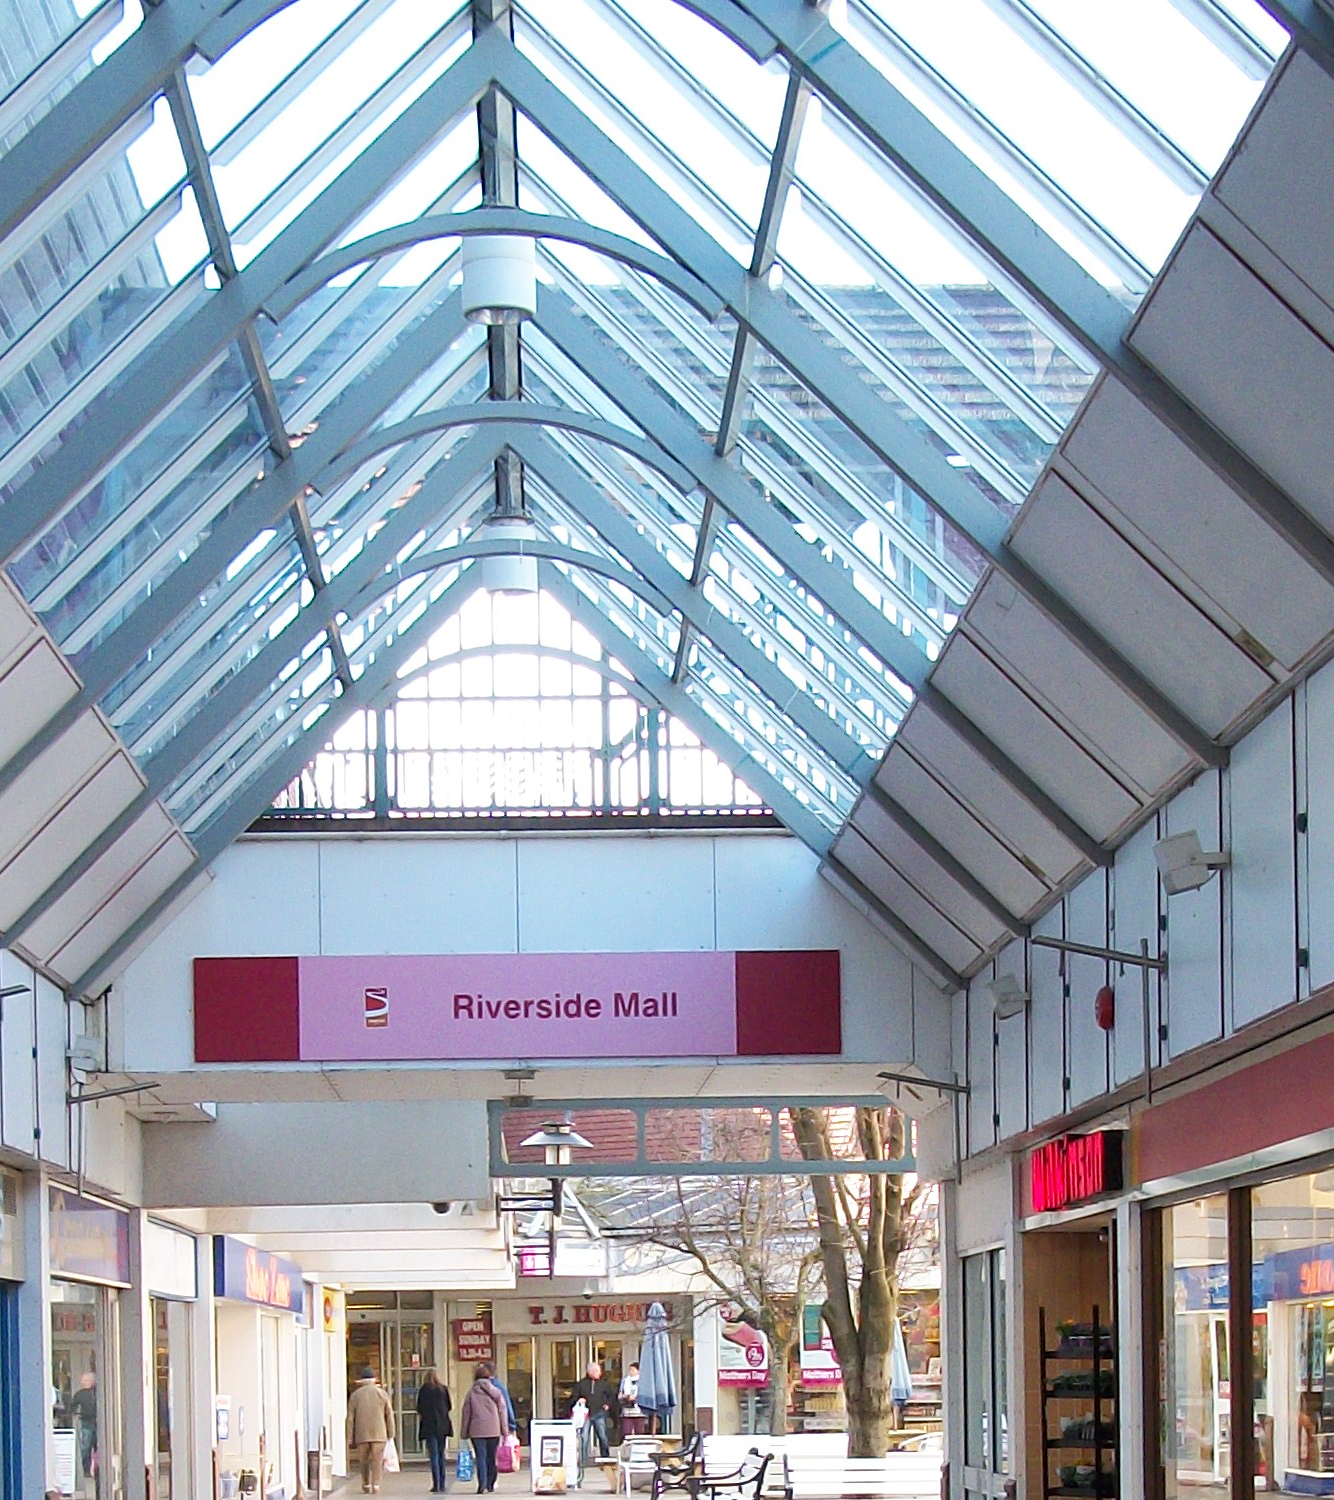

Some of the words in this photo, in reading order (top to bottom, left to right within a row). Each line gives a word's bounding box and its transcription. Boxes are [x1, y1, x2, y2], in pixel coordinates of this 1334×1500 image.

[453, 993, 601, 1020] Riverside
[613, 992, 678, 1018] Mall
[529, 1306, 548, 1324] T.
[553, 1305, 569, 1324] J.
[462, 1320, 485, 1332] OPEN
